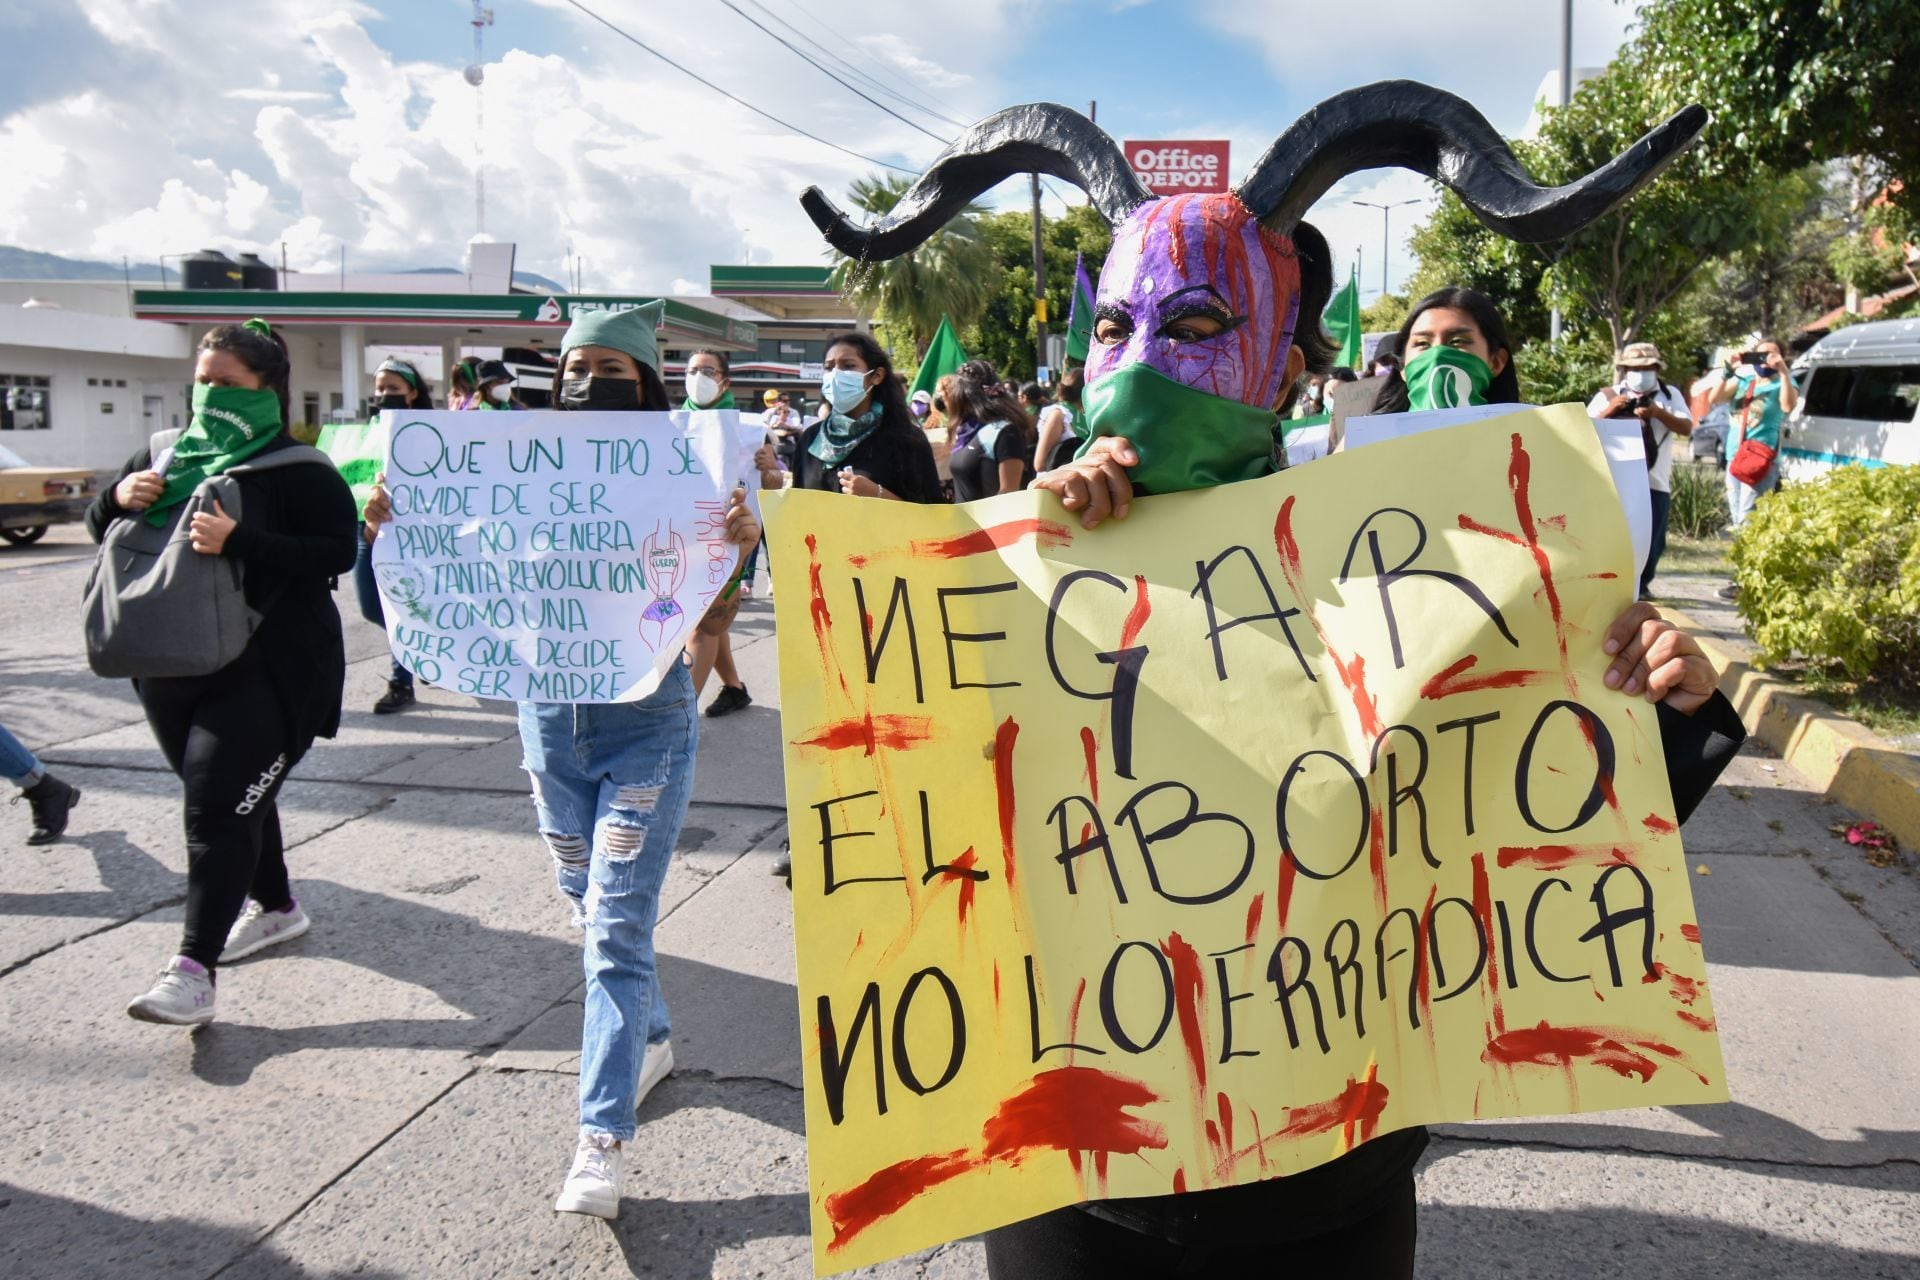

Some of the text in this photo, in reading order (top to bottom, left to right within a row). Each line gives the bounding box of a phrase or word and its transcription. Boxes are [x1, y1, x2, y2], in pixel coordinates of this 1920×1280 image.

[1134, 149, 1218, 170] Office
[1136, 171, 1218, 187] DEPOT
[509, 437, 564, 474] UN
[586, 438, 650, 476] TIPO
[667, 436, 704, 476] SE
[390, 481, 614, 518] OLVIDE DE SER
[395, 520, 635, 560] PADRE NO GENERA
[431, 557, 648, 596] TANTA REVOLUCION
[436, 598, 589, 632] COMO UNA
[467, 637, 522, 668] QUE
[536, 637, 626, 669] DECIDE
[851, 507, 1519, 781] NEGAR
[402, 650, 627, 701] NO SER MADRE
[812, 699, 1616, 906] EL ABORTO
[818, 862, 1656, 1125] NO LO ERRADICA
